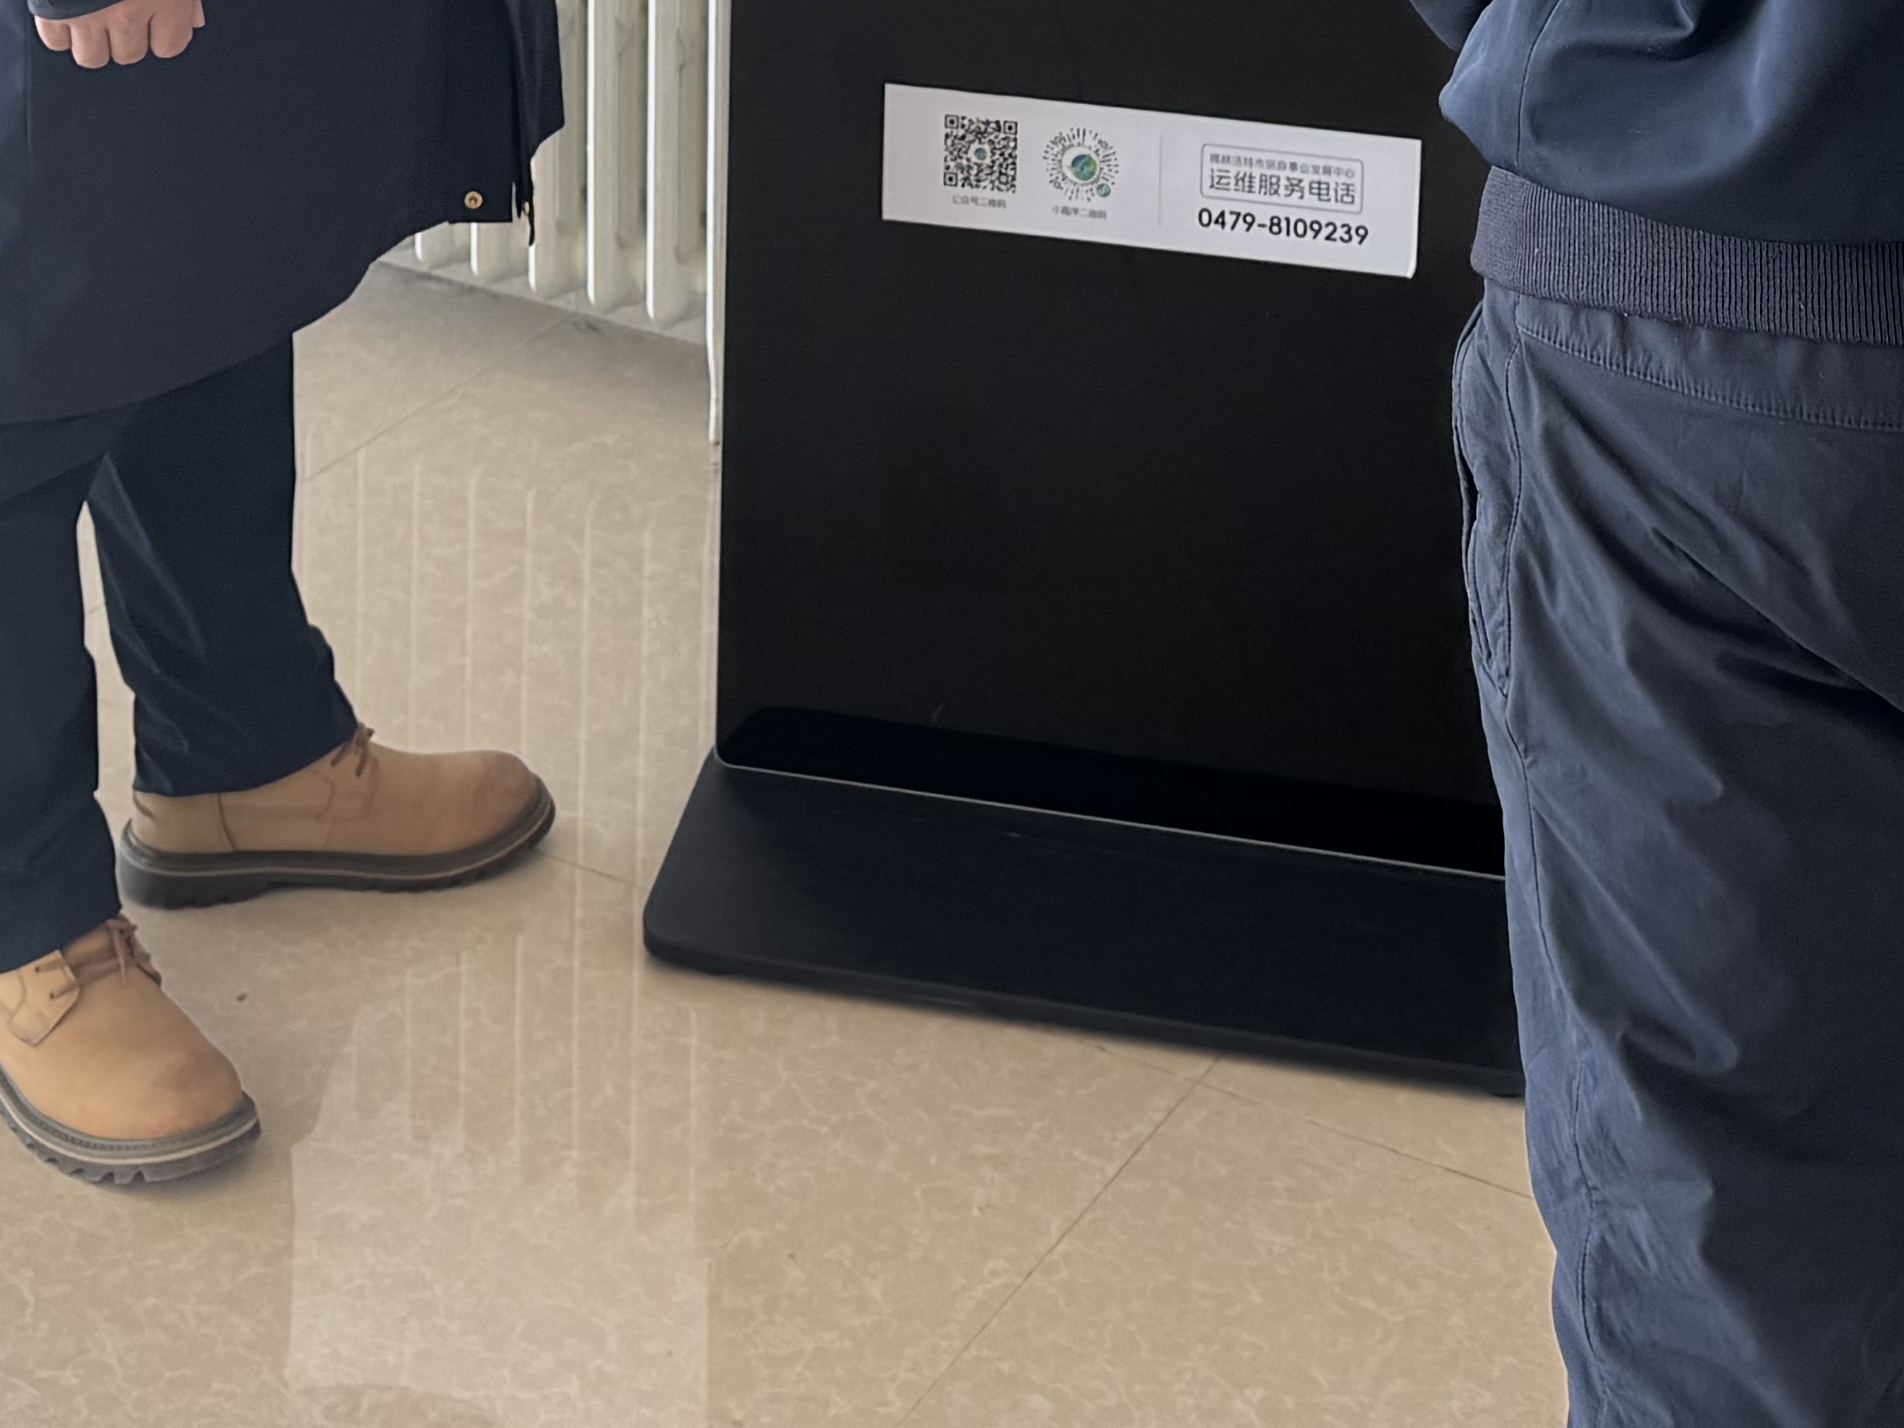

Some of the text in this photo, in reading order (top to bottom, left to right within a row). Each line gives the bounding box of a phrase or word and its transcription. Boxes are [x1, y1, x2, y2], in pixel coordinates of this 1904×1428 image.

[1209, 168, 1356, 205] 运维服务电话
[1198, 207, 1369, 245] 0479-8109239
